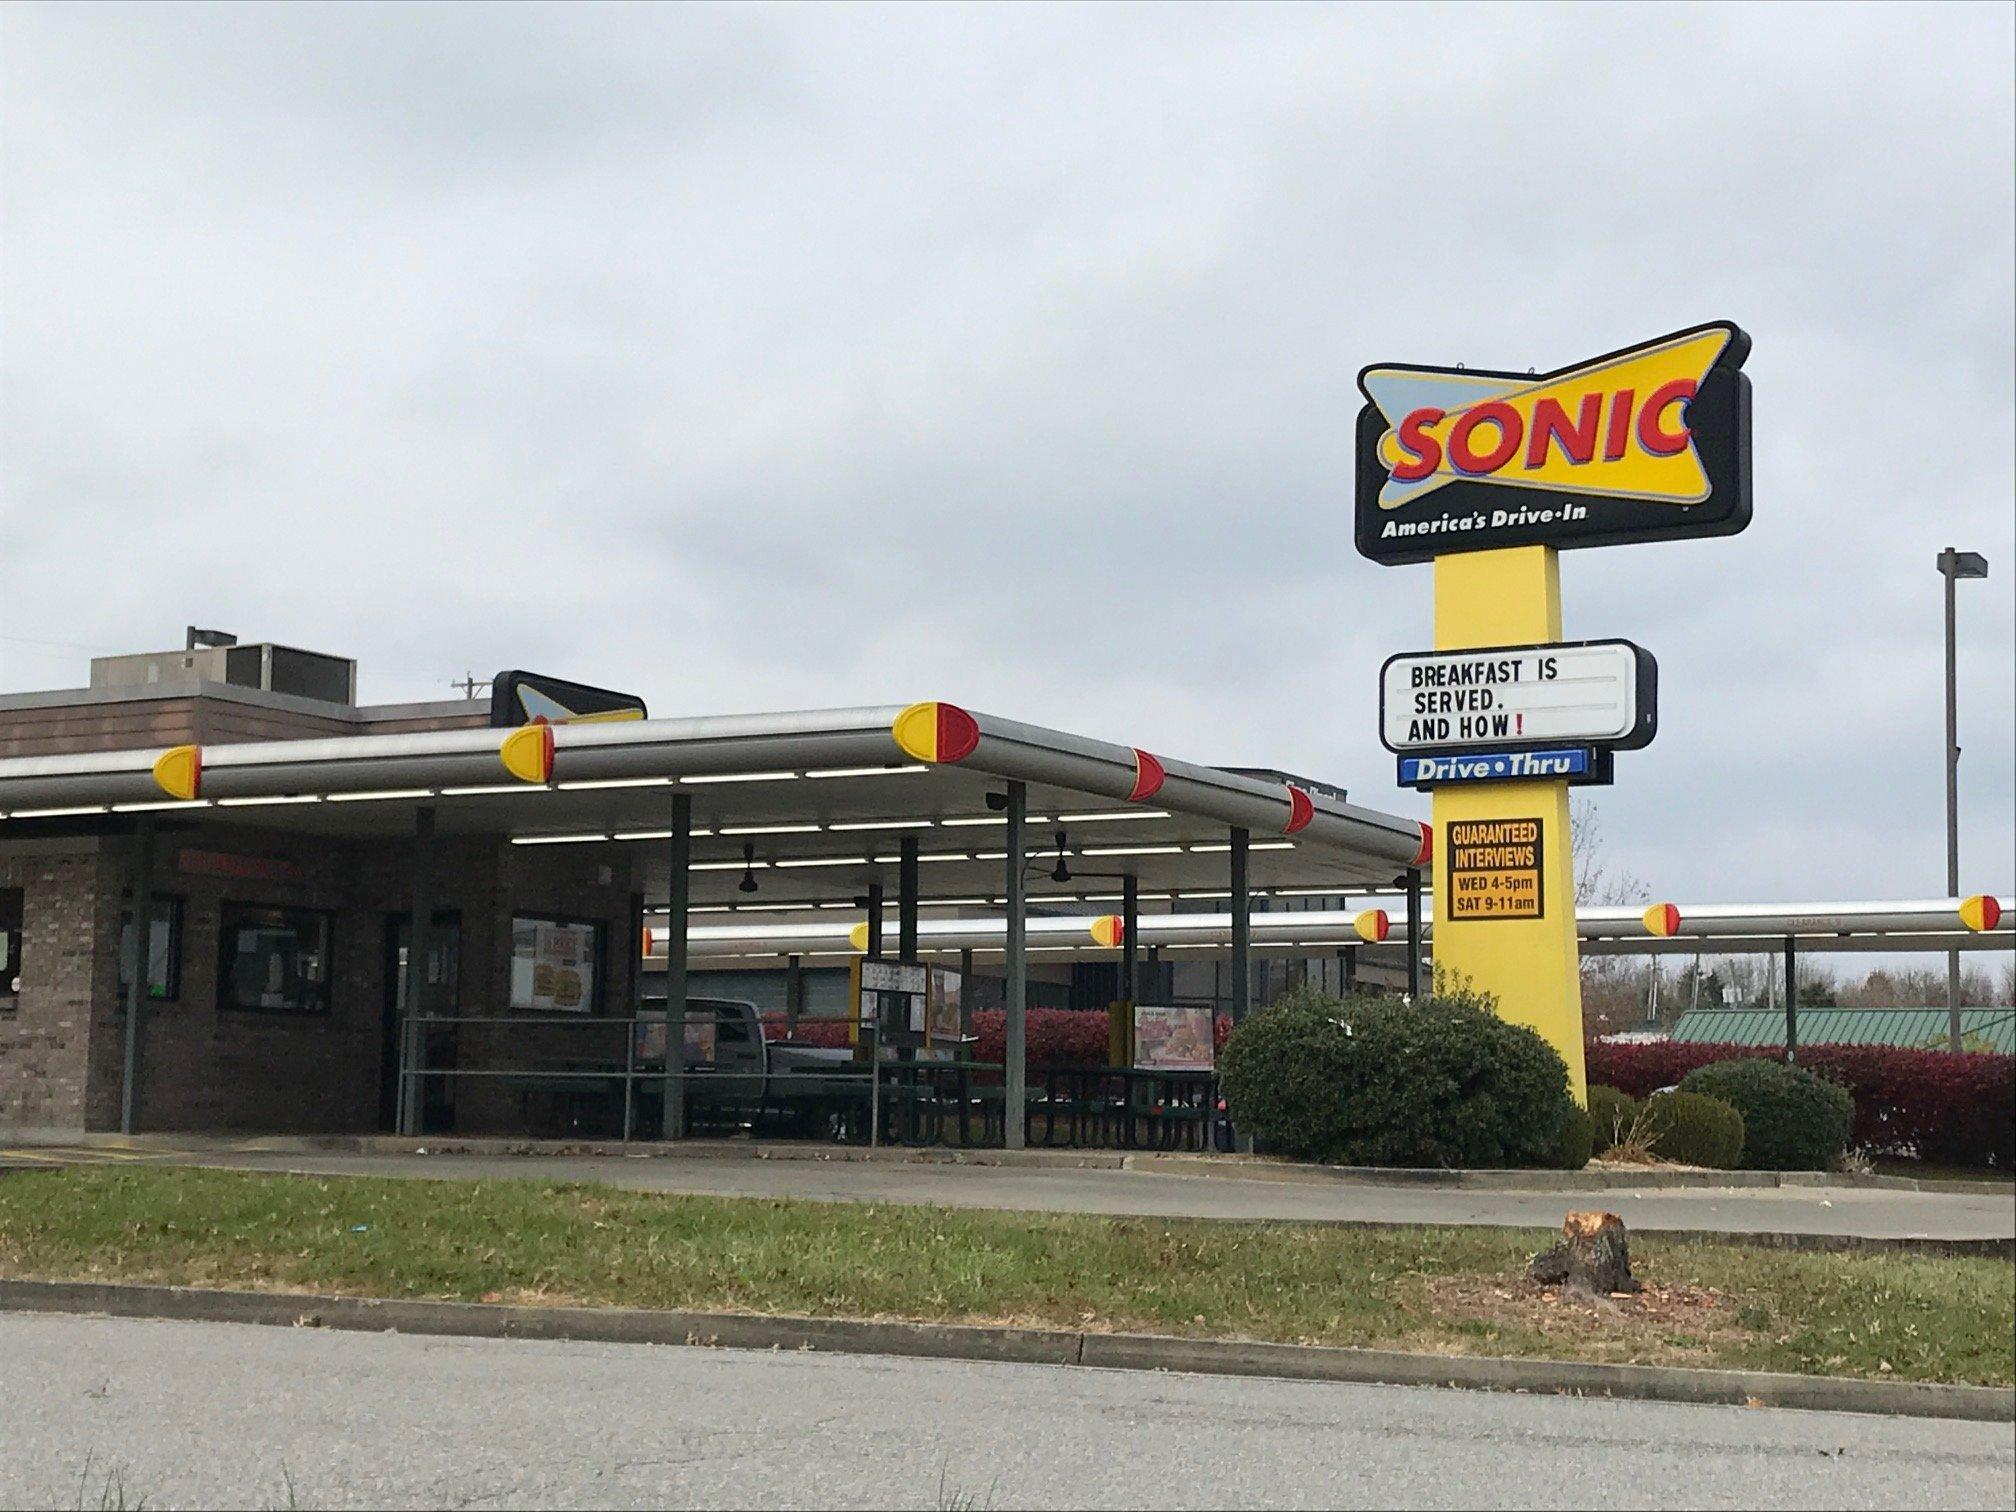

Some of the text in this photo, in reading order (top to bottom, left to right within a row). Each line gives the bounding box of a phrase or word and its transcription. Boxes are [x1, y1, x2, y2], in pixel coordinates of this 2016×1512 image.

[1390, 378, 1698, 483] SONIC
[1381, 511, 1486, 539] America's
[1411, 657, 1558, 688] BREAKFAST IS
[1414, 688, 1504, 714] SERVED.
[1408, 713, 1523, 741] AND HOW!
[1453, 822, 1537, 845] GUARANTEED
[1455, 846, 1535, 868] INTERVIEWS
[1458, 876, 1532, 892] WED 4-5pm
[1457, 896, 1534, 911] SAT 9-11am
